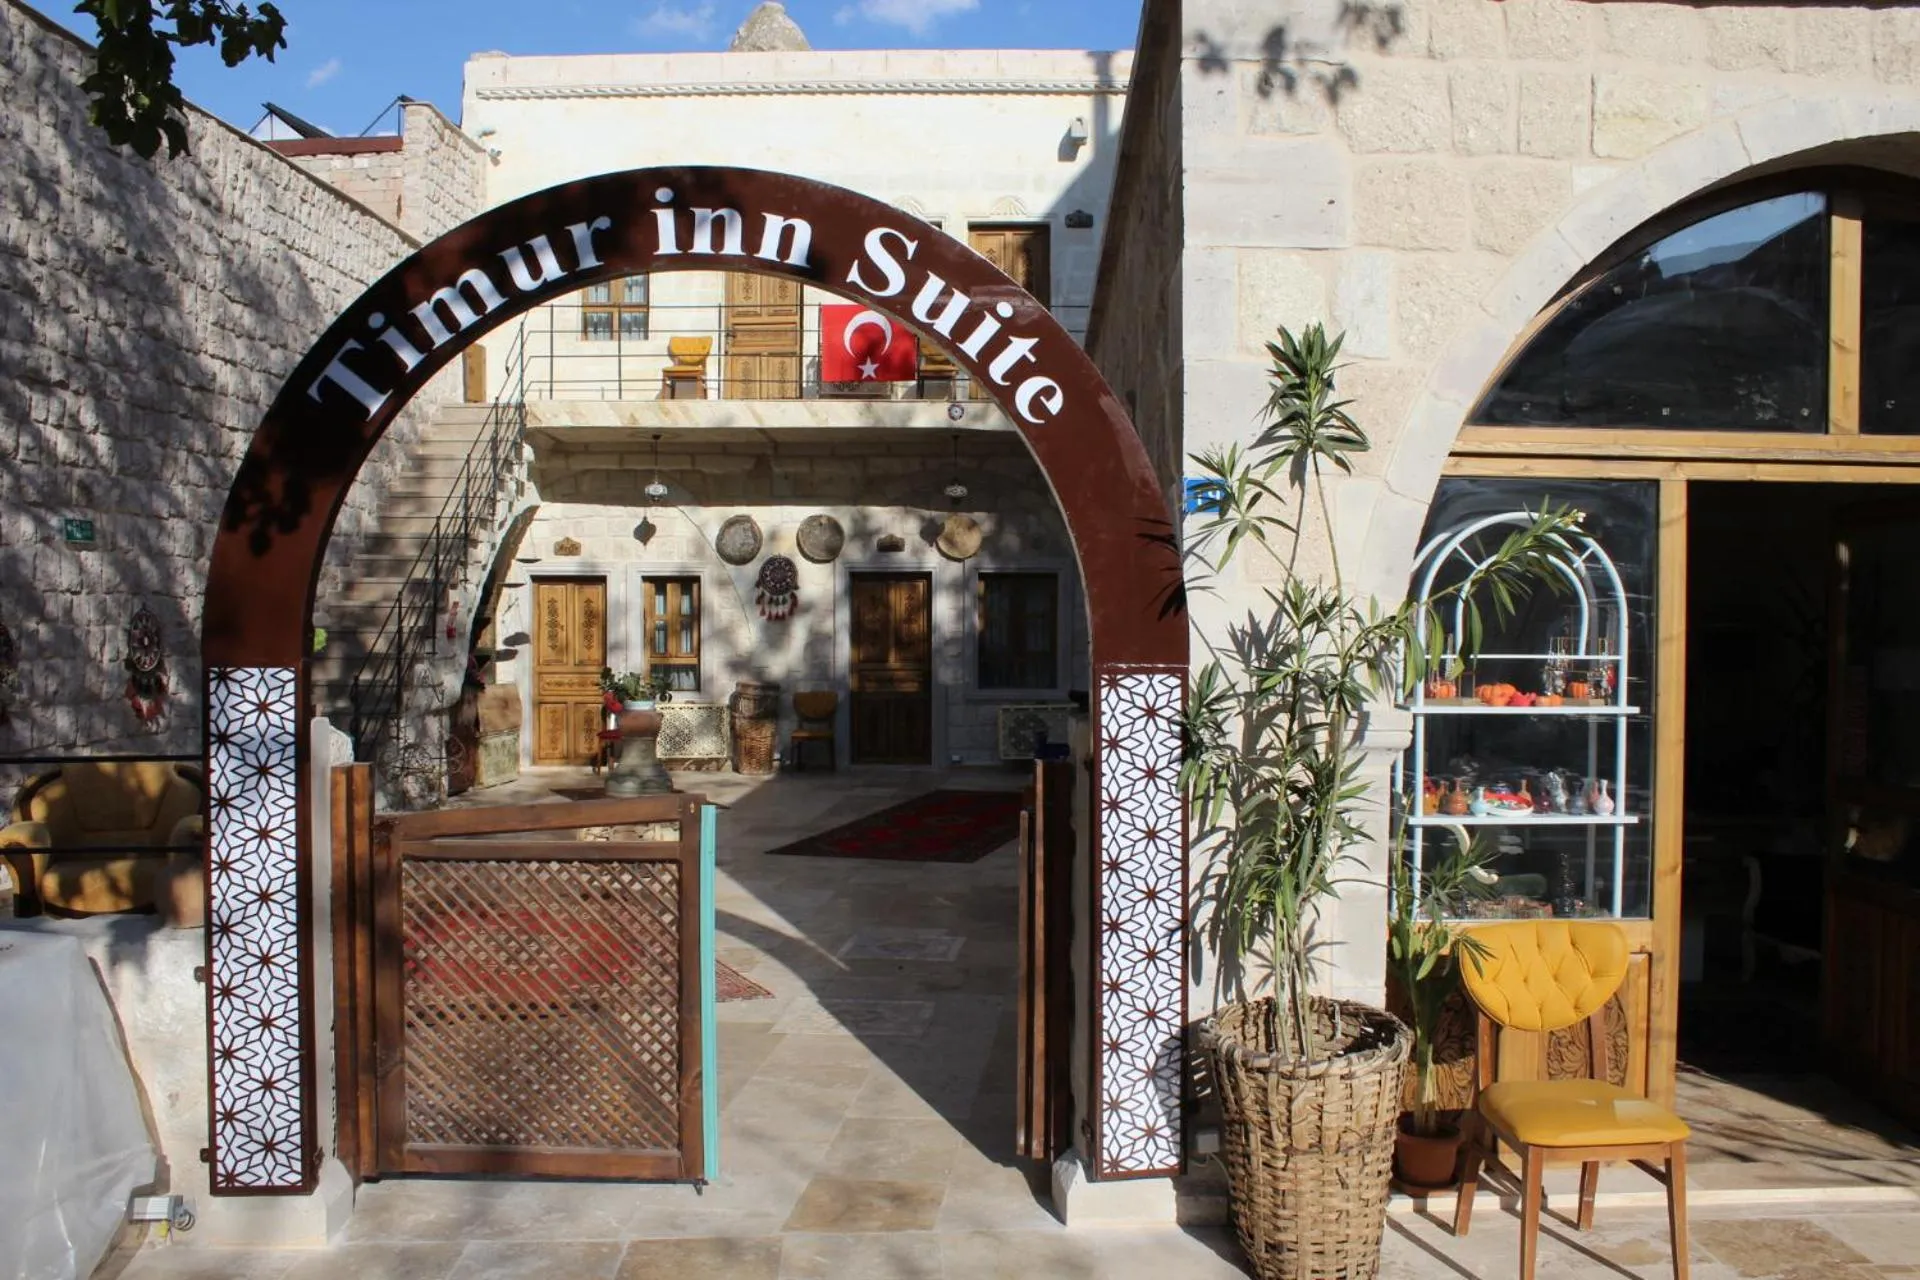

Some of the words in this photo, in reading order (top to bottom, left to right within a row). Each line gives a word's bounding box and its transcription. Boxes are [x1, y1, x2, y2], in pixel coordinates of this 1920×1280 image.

[307, 216, 611, 421] Timur
[649, 187, 812, 267] inn
[846, 227, 1064, 424] Suite
